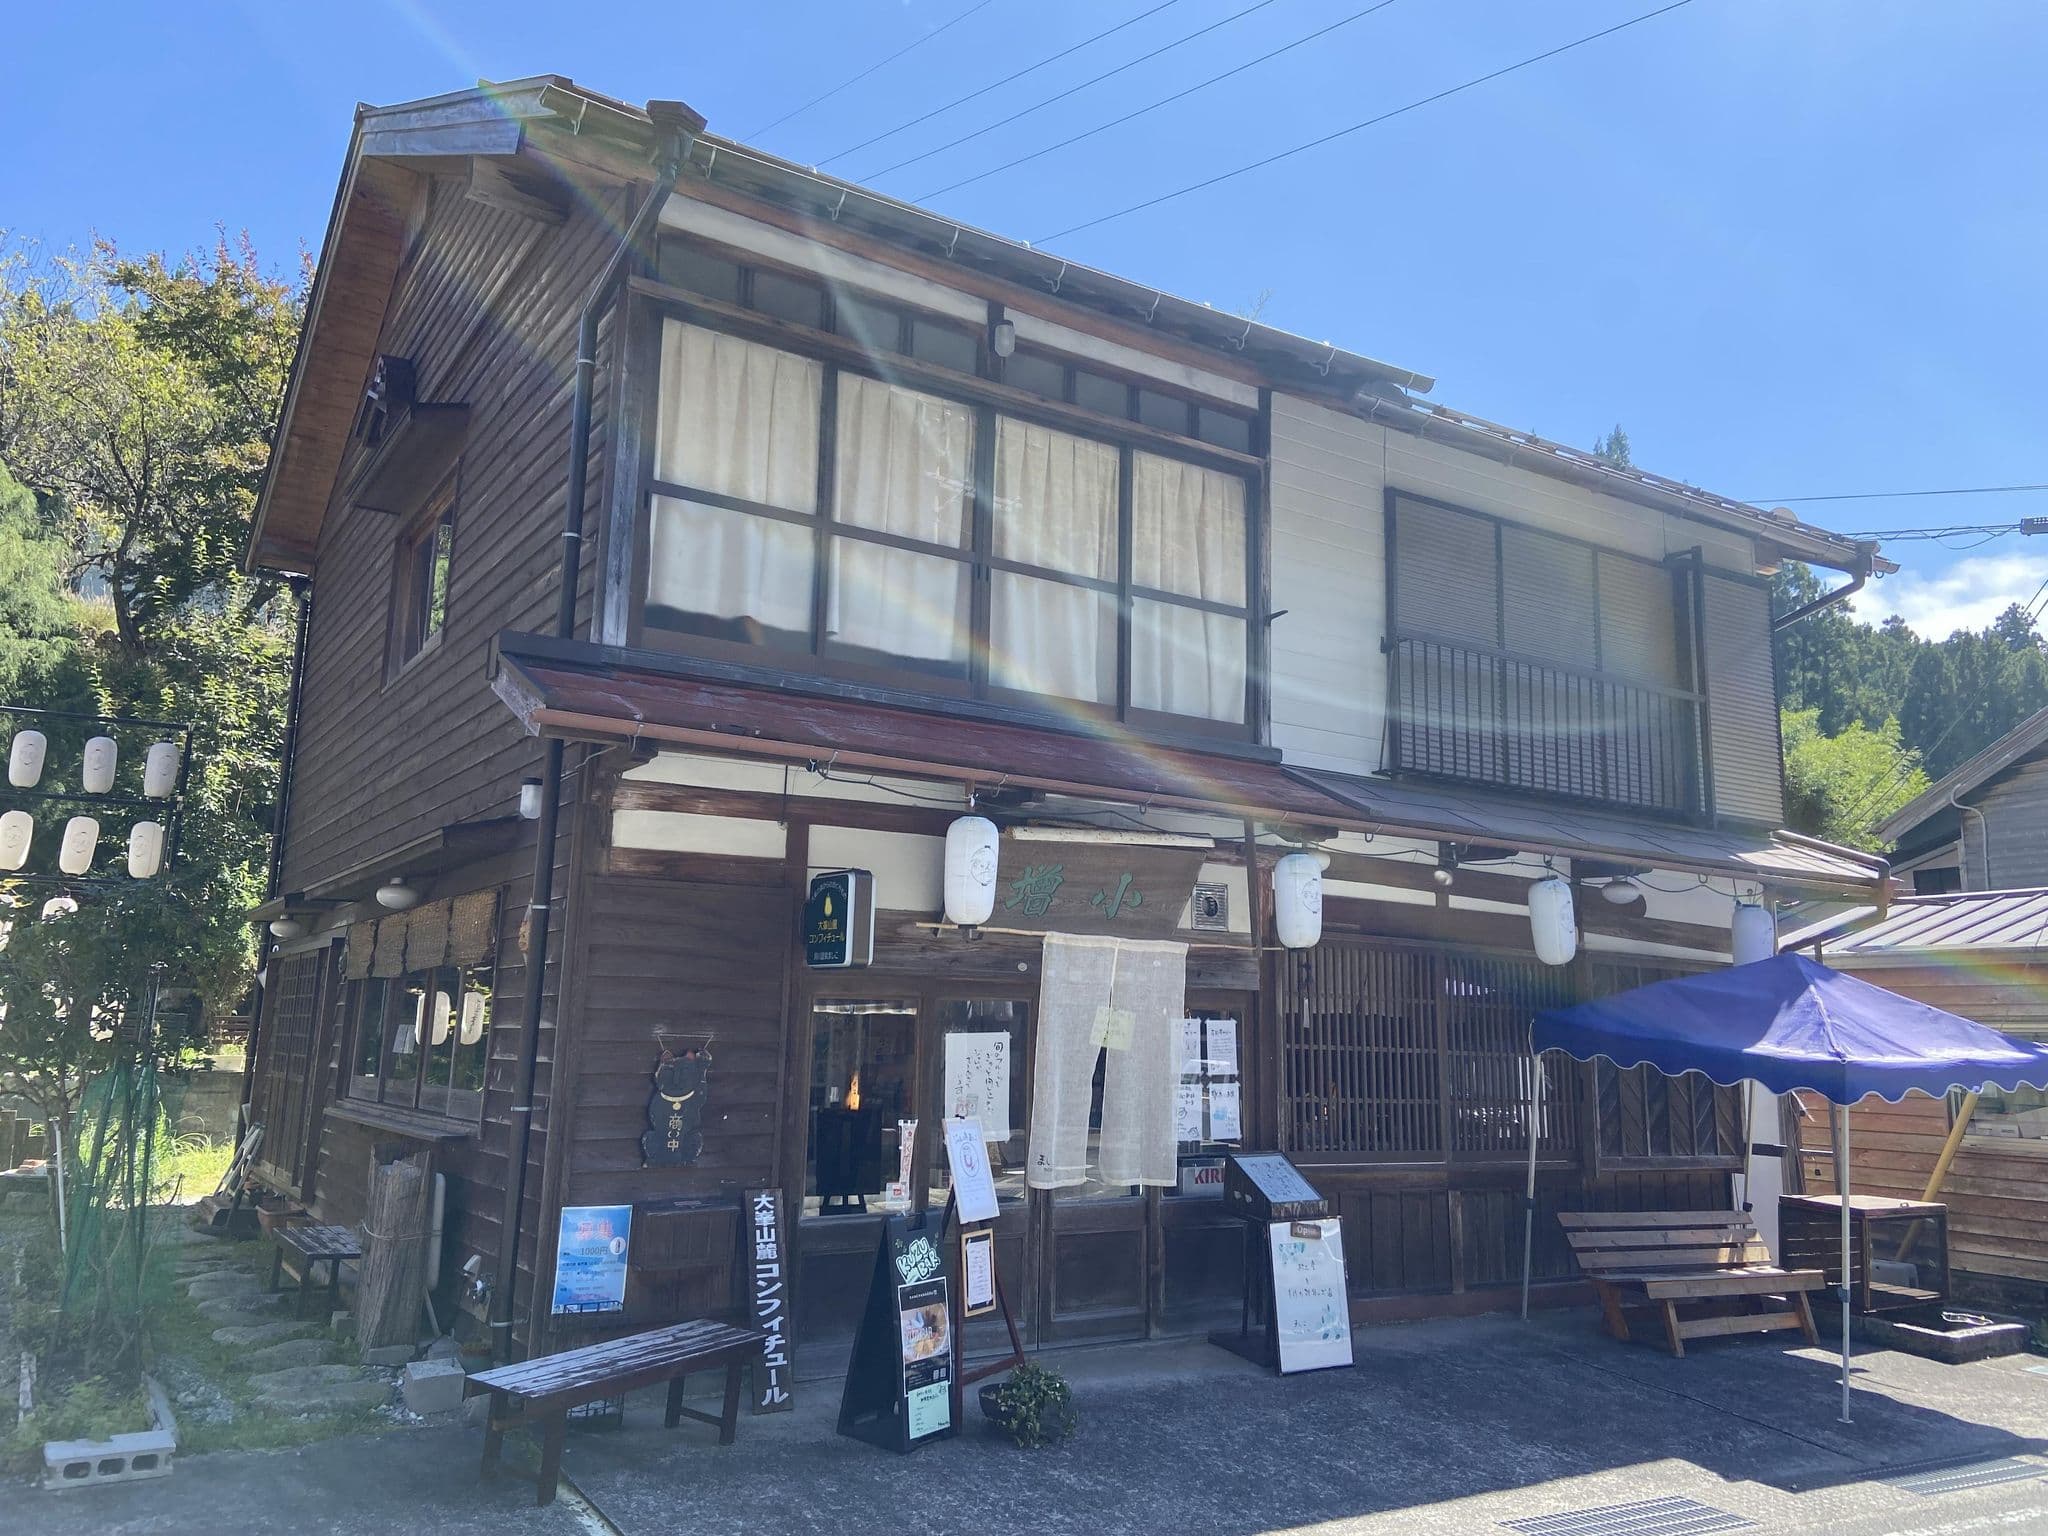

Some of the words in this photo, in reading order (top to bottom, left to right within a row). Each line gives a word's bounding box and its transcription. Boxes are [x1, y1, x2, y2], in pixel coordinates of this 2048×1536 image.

[808, 931, 845, 944] コンフィチュール
[667, 1113, 682, 1152] 商い中
[897, 1238, 929, 1278] KUZU
[918, 1249, 939, 1279] BAR
